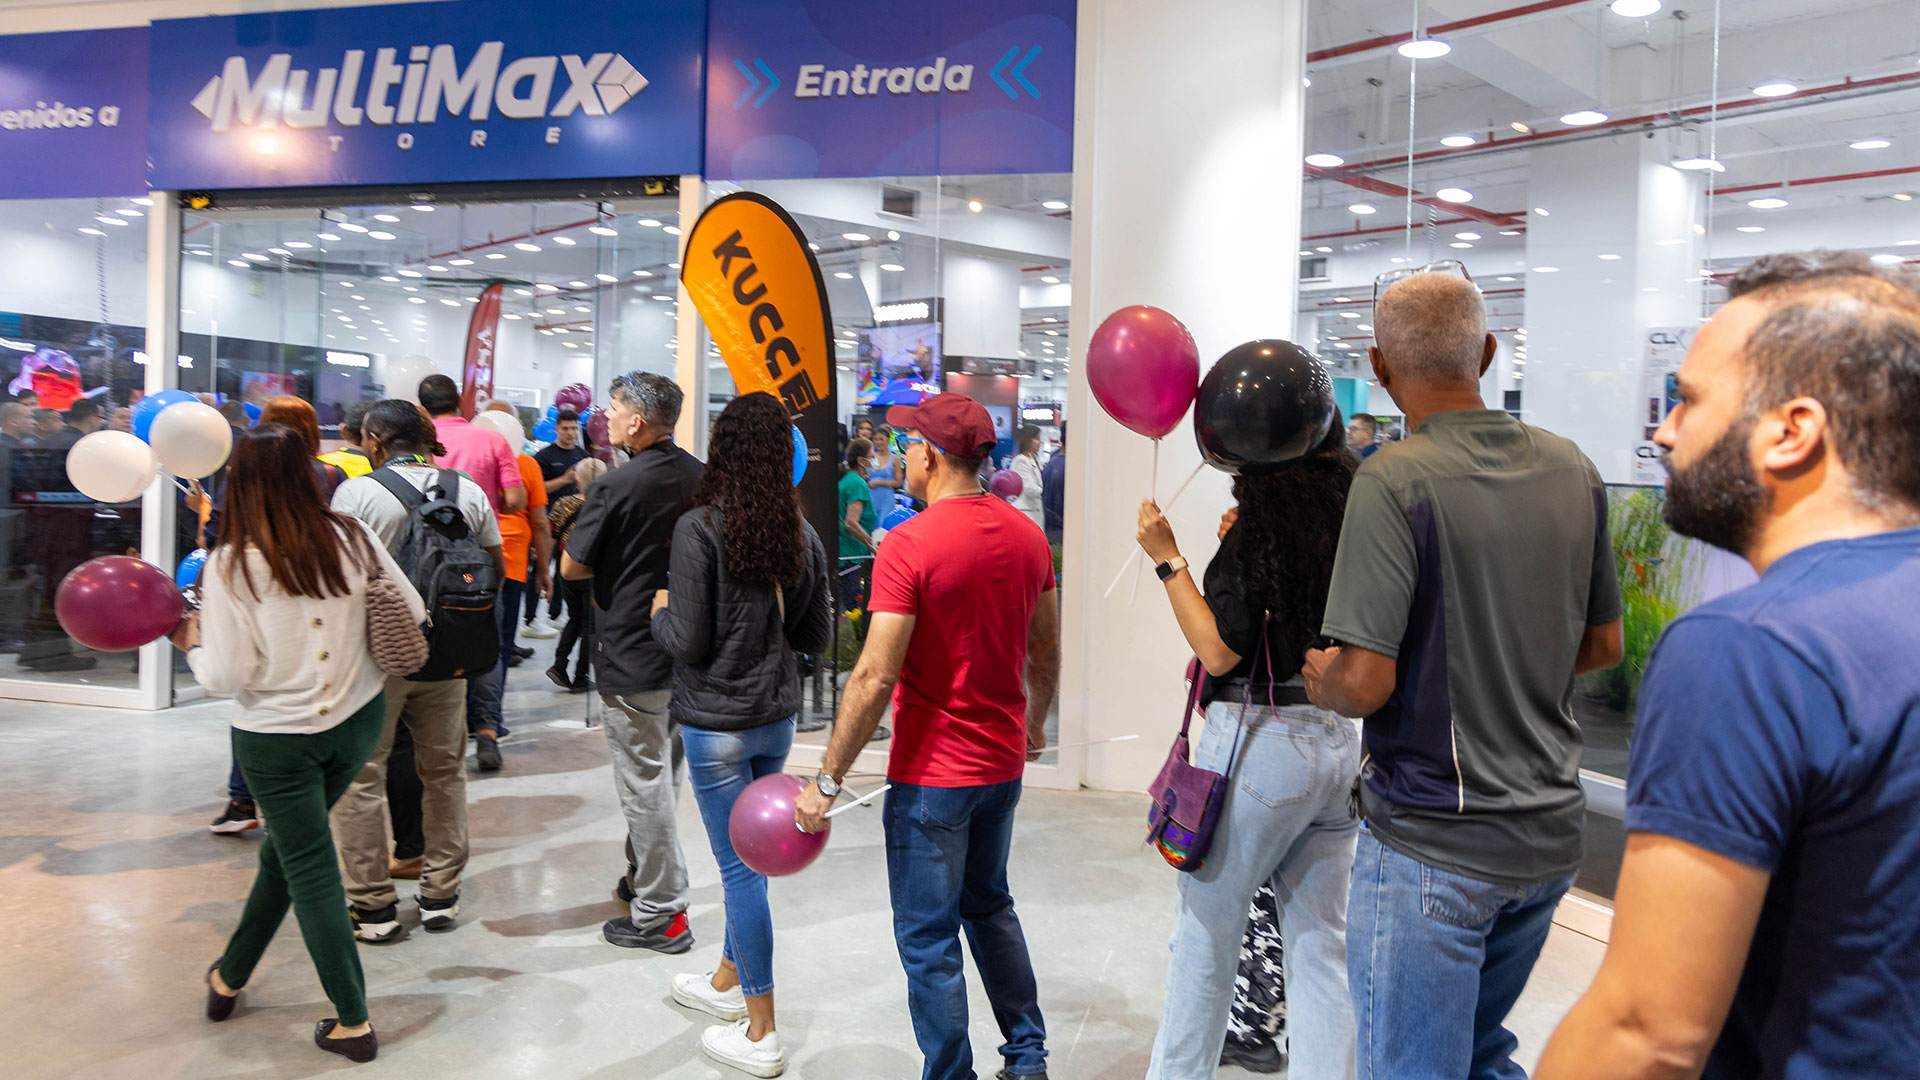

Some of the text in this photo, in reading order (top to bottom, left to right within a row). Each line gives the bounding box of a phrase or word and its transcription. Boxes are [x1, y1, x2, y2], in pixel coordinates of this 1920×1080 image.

[210, 40, 615, 132] MultiMax
[795, 57, 974, 97] Entrada
[0, 100, 120, 130] enidos a
[260, 126, 562, 155] TORE
